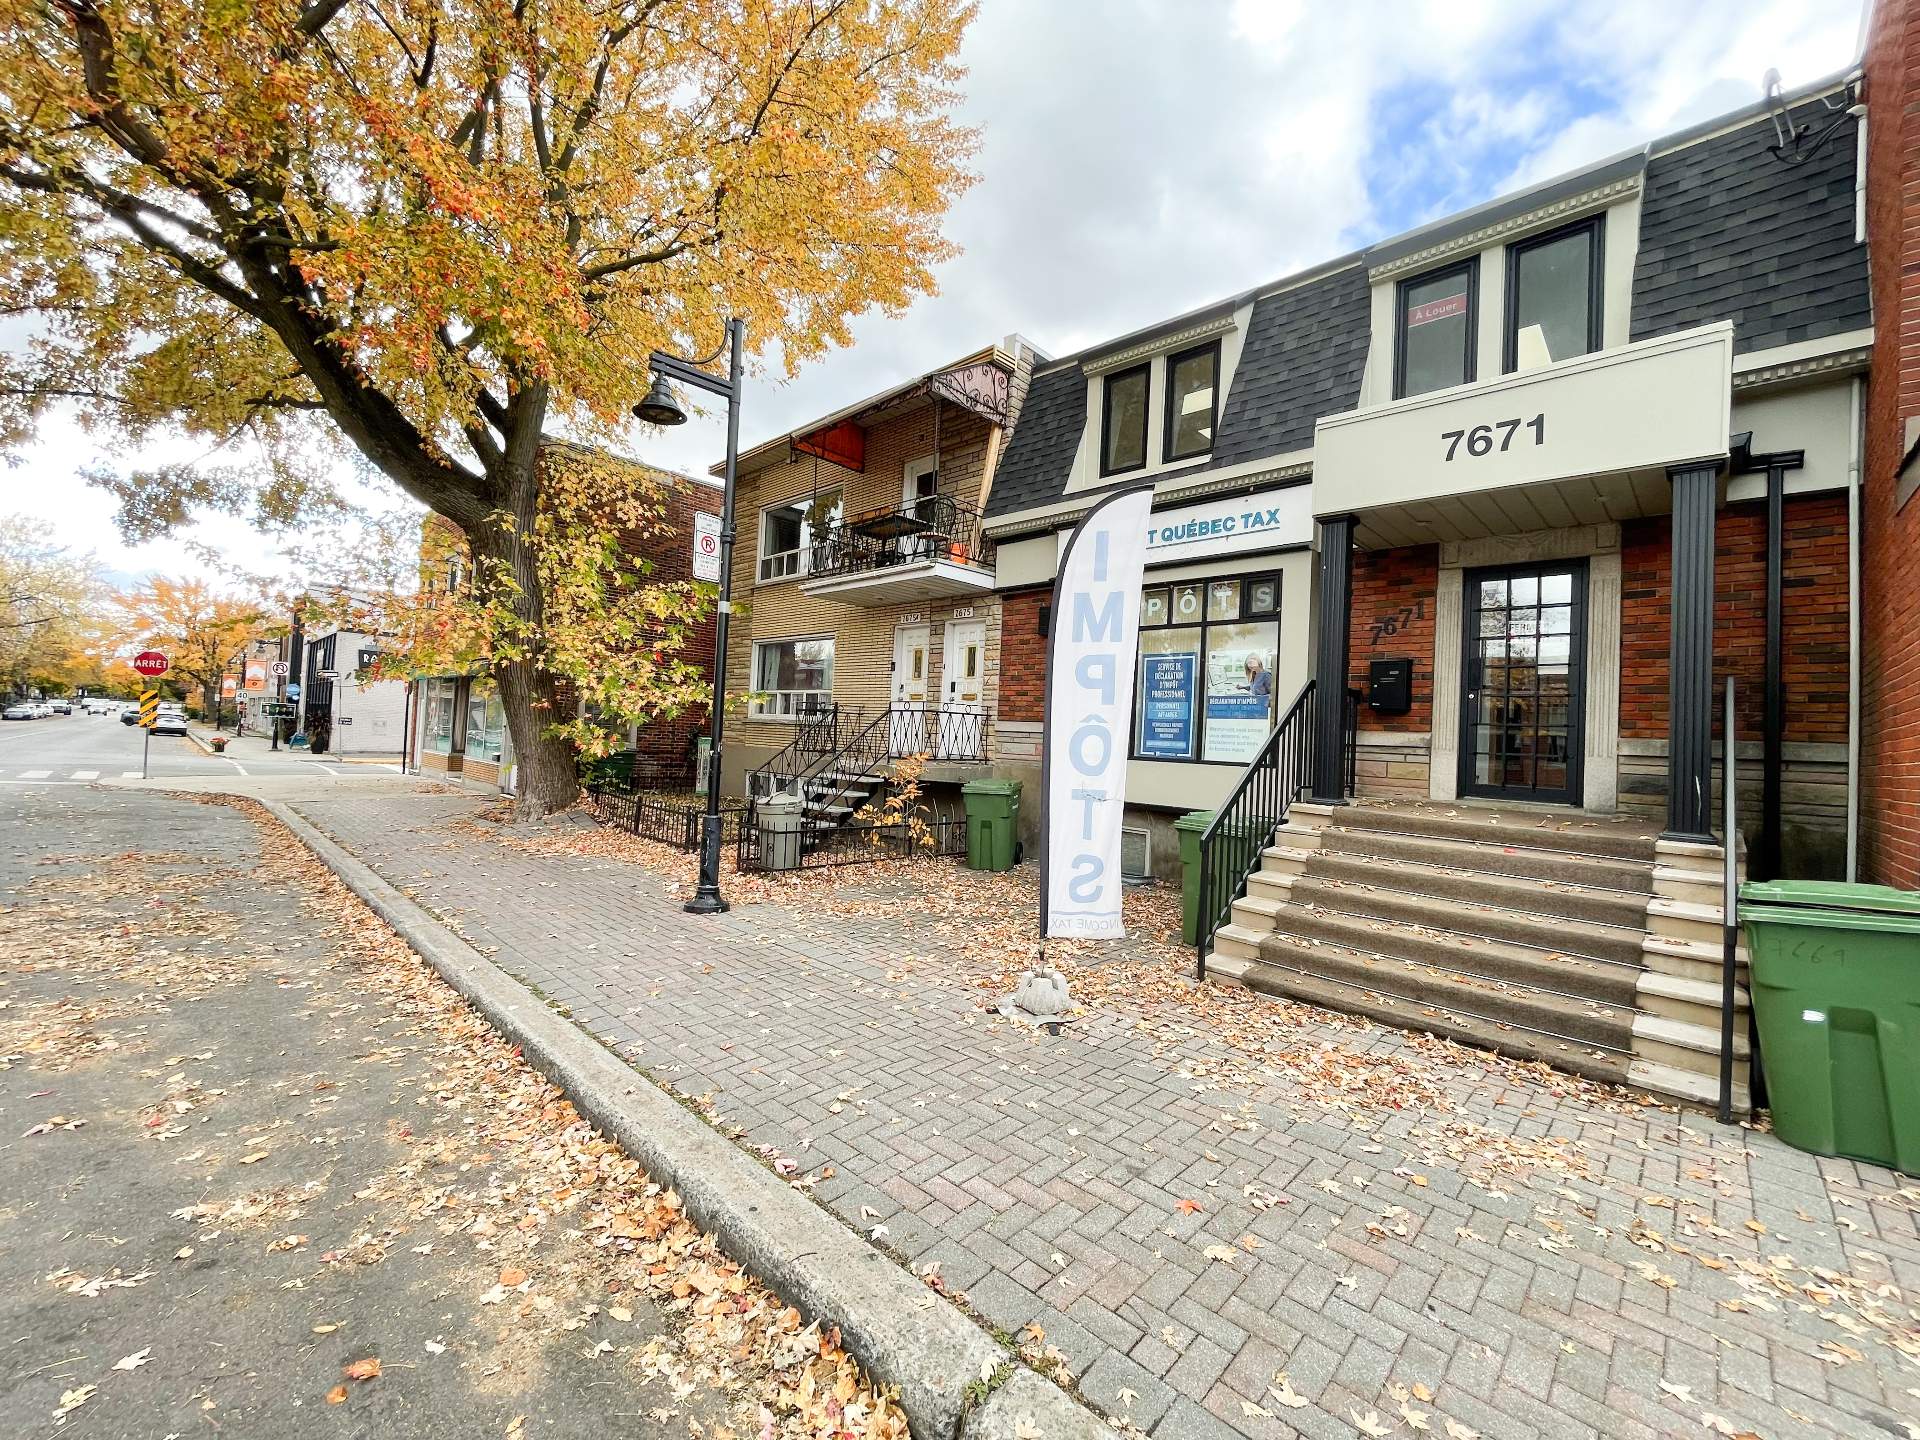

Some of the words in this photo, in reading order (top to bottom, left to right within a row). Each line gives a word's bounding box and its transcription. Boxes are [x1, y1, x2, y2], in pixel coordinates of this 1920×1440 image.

[1426, 302, 1458, 317] Louer
[1441, 413, 1545, 461] 7671
[1161, 516, 1236, 542] QUÉBEC
[1241, 508, 1281, 529] TAX
[1370, 601, 1424, 645] 7671
